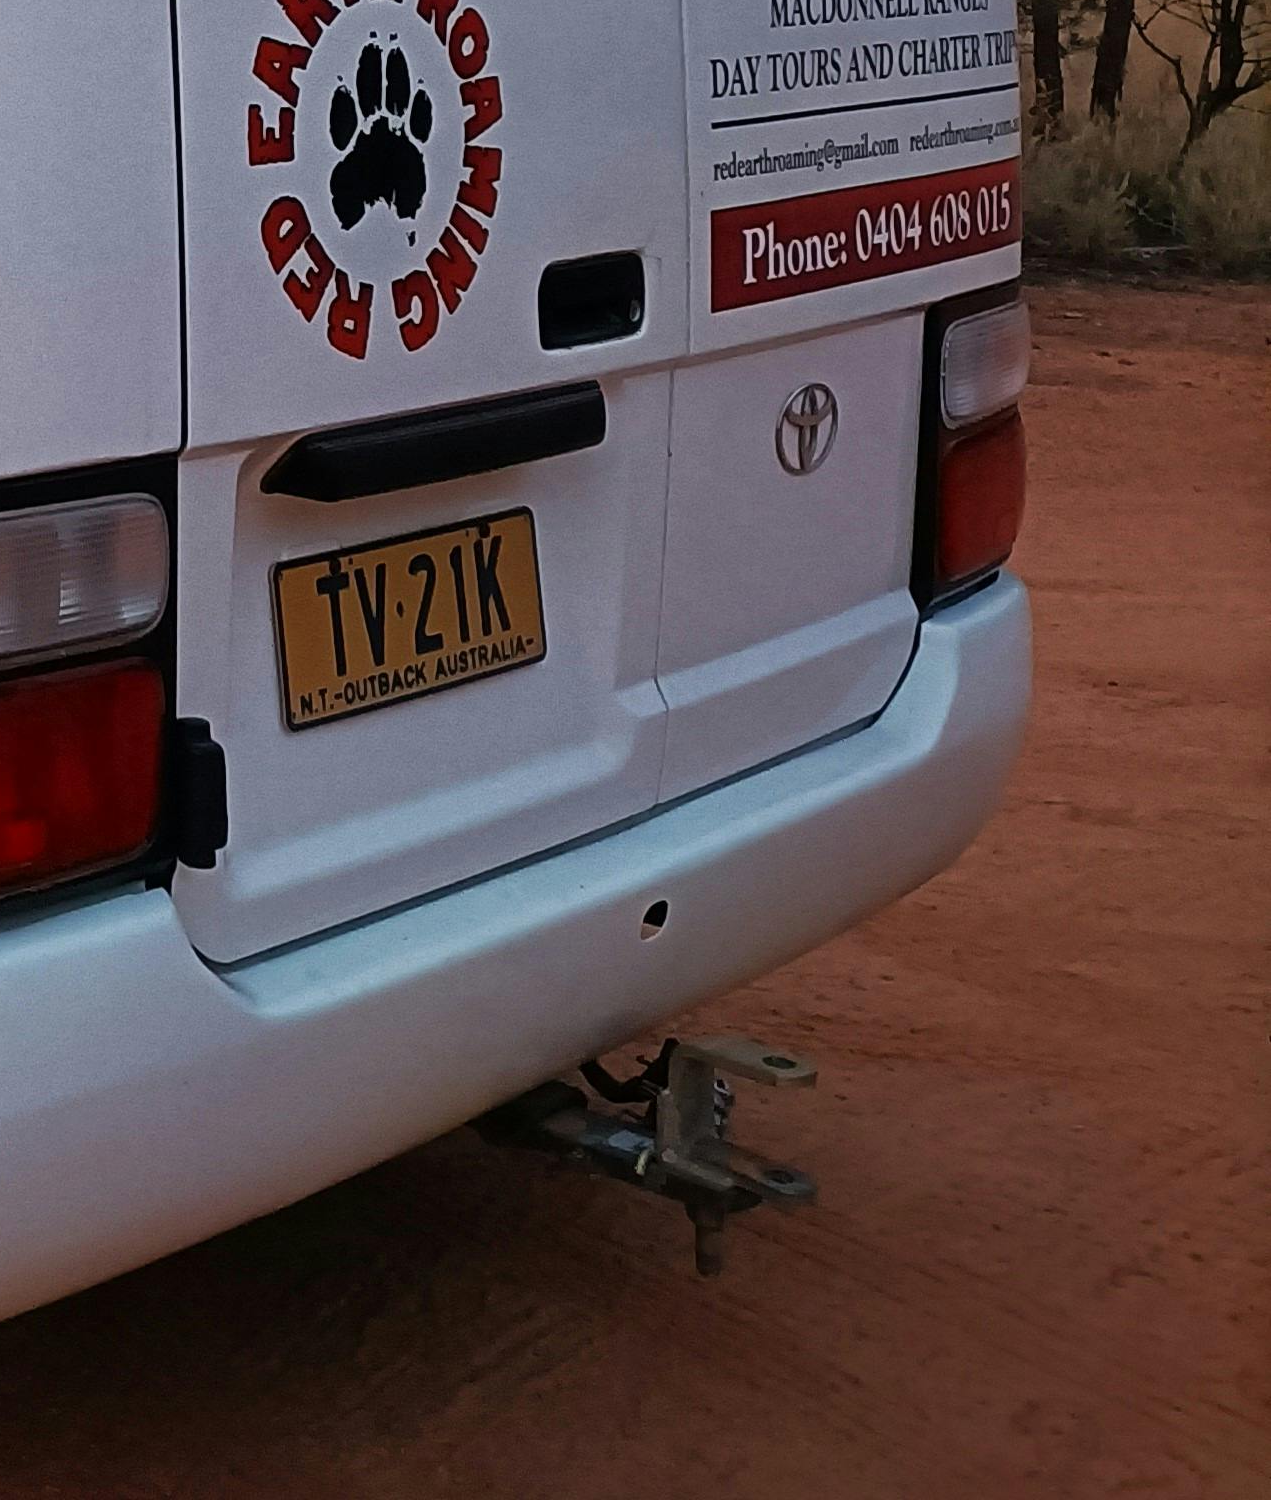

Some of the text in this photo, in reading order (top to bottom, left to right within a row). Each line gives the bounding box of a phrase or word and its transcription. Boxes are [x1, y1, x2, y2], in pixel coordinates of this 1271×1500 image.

[709, 27, 1019, 99] DAY TOURS AND CHARTER TRIP
[713, 132, 900, 181] redearthroaming@gmail.com
[742, 181, 1011, 285] Phone: 0404 608 015
[260, 195, 374, 360] RED
